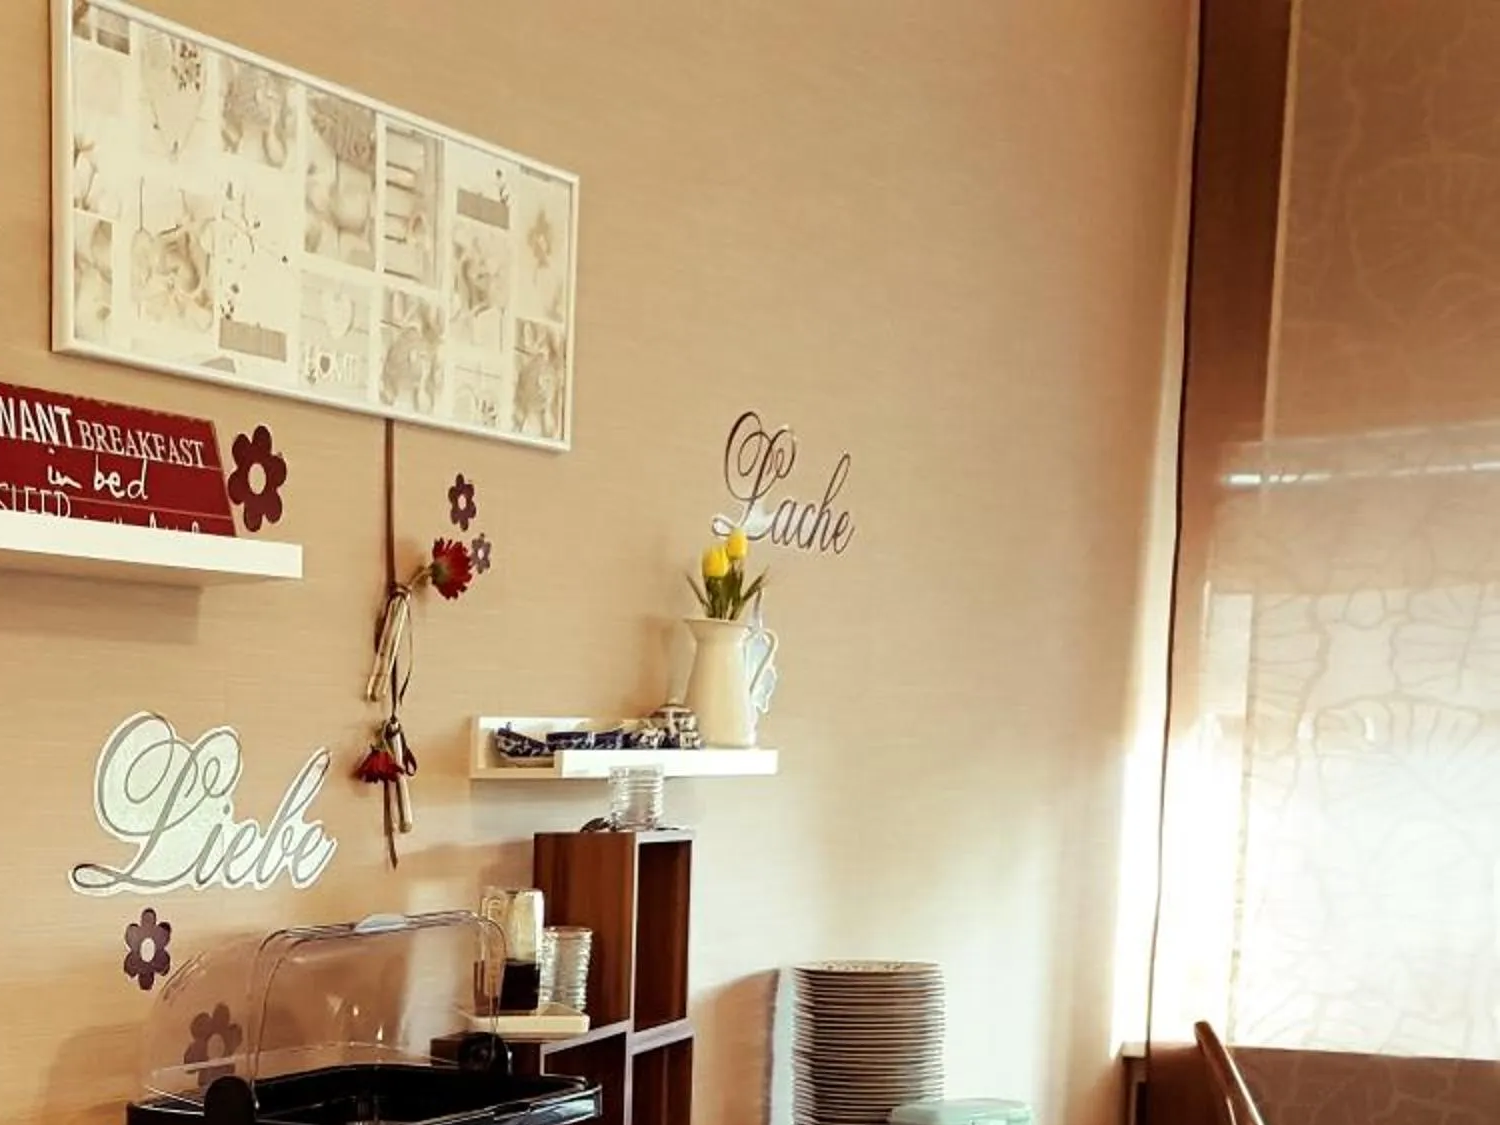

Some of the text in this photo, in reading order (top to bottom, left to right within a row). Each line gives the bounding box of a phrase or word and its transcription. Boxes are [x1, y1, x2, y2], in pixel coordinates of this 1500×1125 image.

[47, 446, 149, 500] in bed
[75, 418, 206, 469] BREAKFAST
[711, 411, 856, 555] Lache
[72, 714, 337, 888] Liebe
